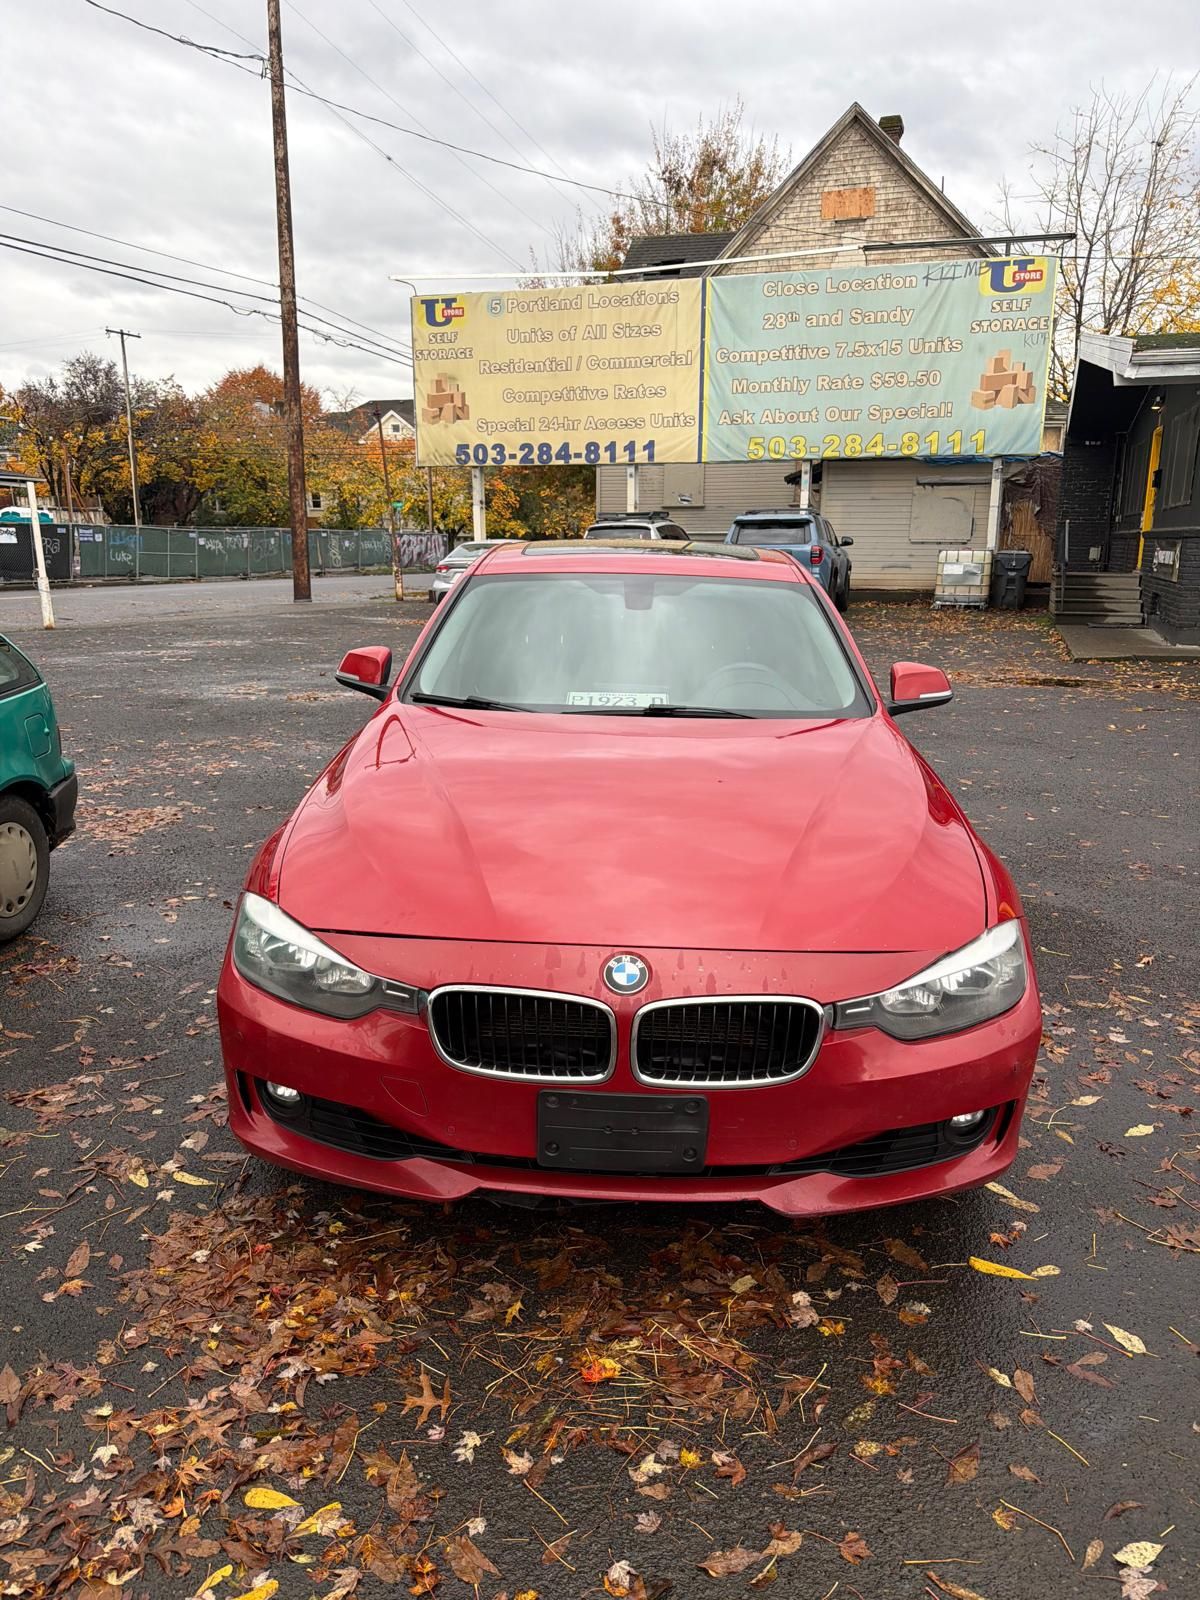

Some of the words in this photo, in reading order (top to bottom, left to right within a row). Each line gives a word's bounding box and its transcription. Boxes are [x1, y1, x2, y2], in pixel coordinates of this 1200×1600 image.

[763, 280, 819, 297] Close
[826, 273, 917, 293] Location
[990, 258, 1035, 293] U
[1014, 271, 1042, 281] STORE
[420, 297, 457, 327] U
[443, 308, 464, 318] STORE
[490, 300, 502, 314] 5
[507, 294, 582, 313] Portland
[588, 290, 679, 309] Locations
[991, 298, 1032, 313] SELF
[762, 311, 800, 330] 28th
[805, 309, 843, 327] and
[849, 306, 915, 326] Sandy
[970, 316, 1050, 333] STORAGE
[428, 332, 458, 344] SELF
[507, 327, 553, 344] Units
[559, 325, 577, 342] of
[583, 324, 607, 340] All
[613, 321, 662, 338] Sizes
[415, 347, 473, 361] STORAGE
[479, 355, 573, 375] Residential
[576, 355, 583, 371] /
[586, 351, 693, 370] Commercial
[716, 344, 830, 366] Competitive
[835, 341, 902, 359] 7.5x15
[909, 337, 963, 355] Units
[503, 385, 608, 405] Competitive
[614, 384, 666, 399] Rates
[731, 375, 810, 396] Monthly
[816, 373, 864, 391] Rate
[870, 370, 941, 390] $59.50
[476, 417, 535, 435] Special
[538, 416, 581, 431] 24-hr
[585, 414, 645, 429] Access
[651, 412, 696, 428] Units
[718, 408, 754, 426] Ask
[760, 406, 819, 424] About
[825, 405, 860, 422] Our
[867, 402, 953, 424] Special!
[455, 439, 656, 464] 503-284-8111
[748, 429, 987, 460] 503-284-8111
[609, 955, 646, 969] BMW
